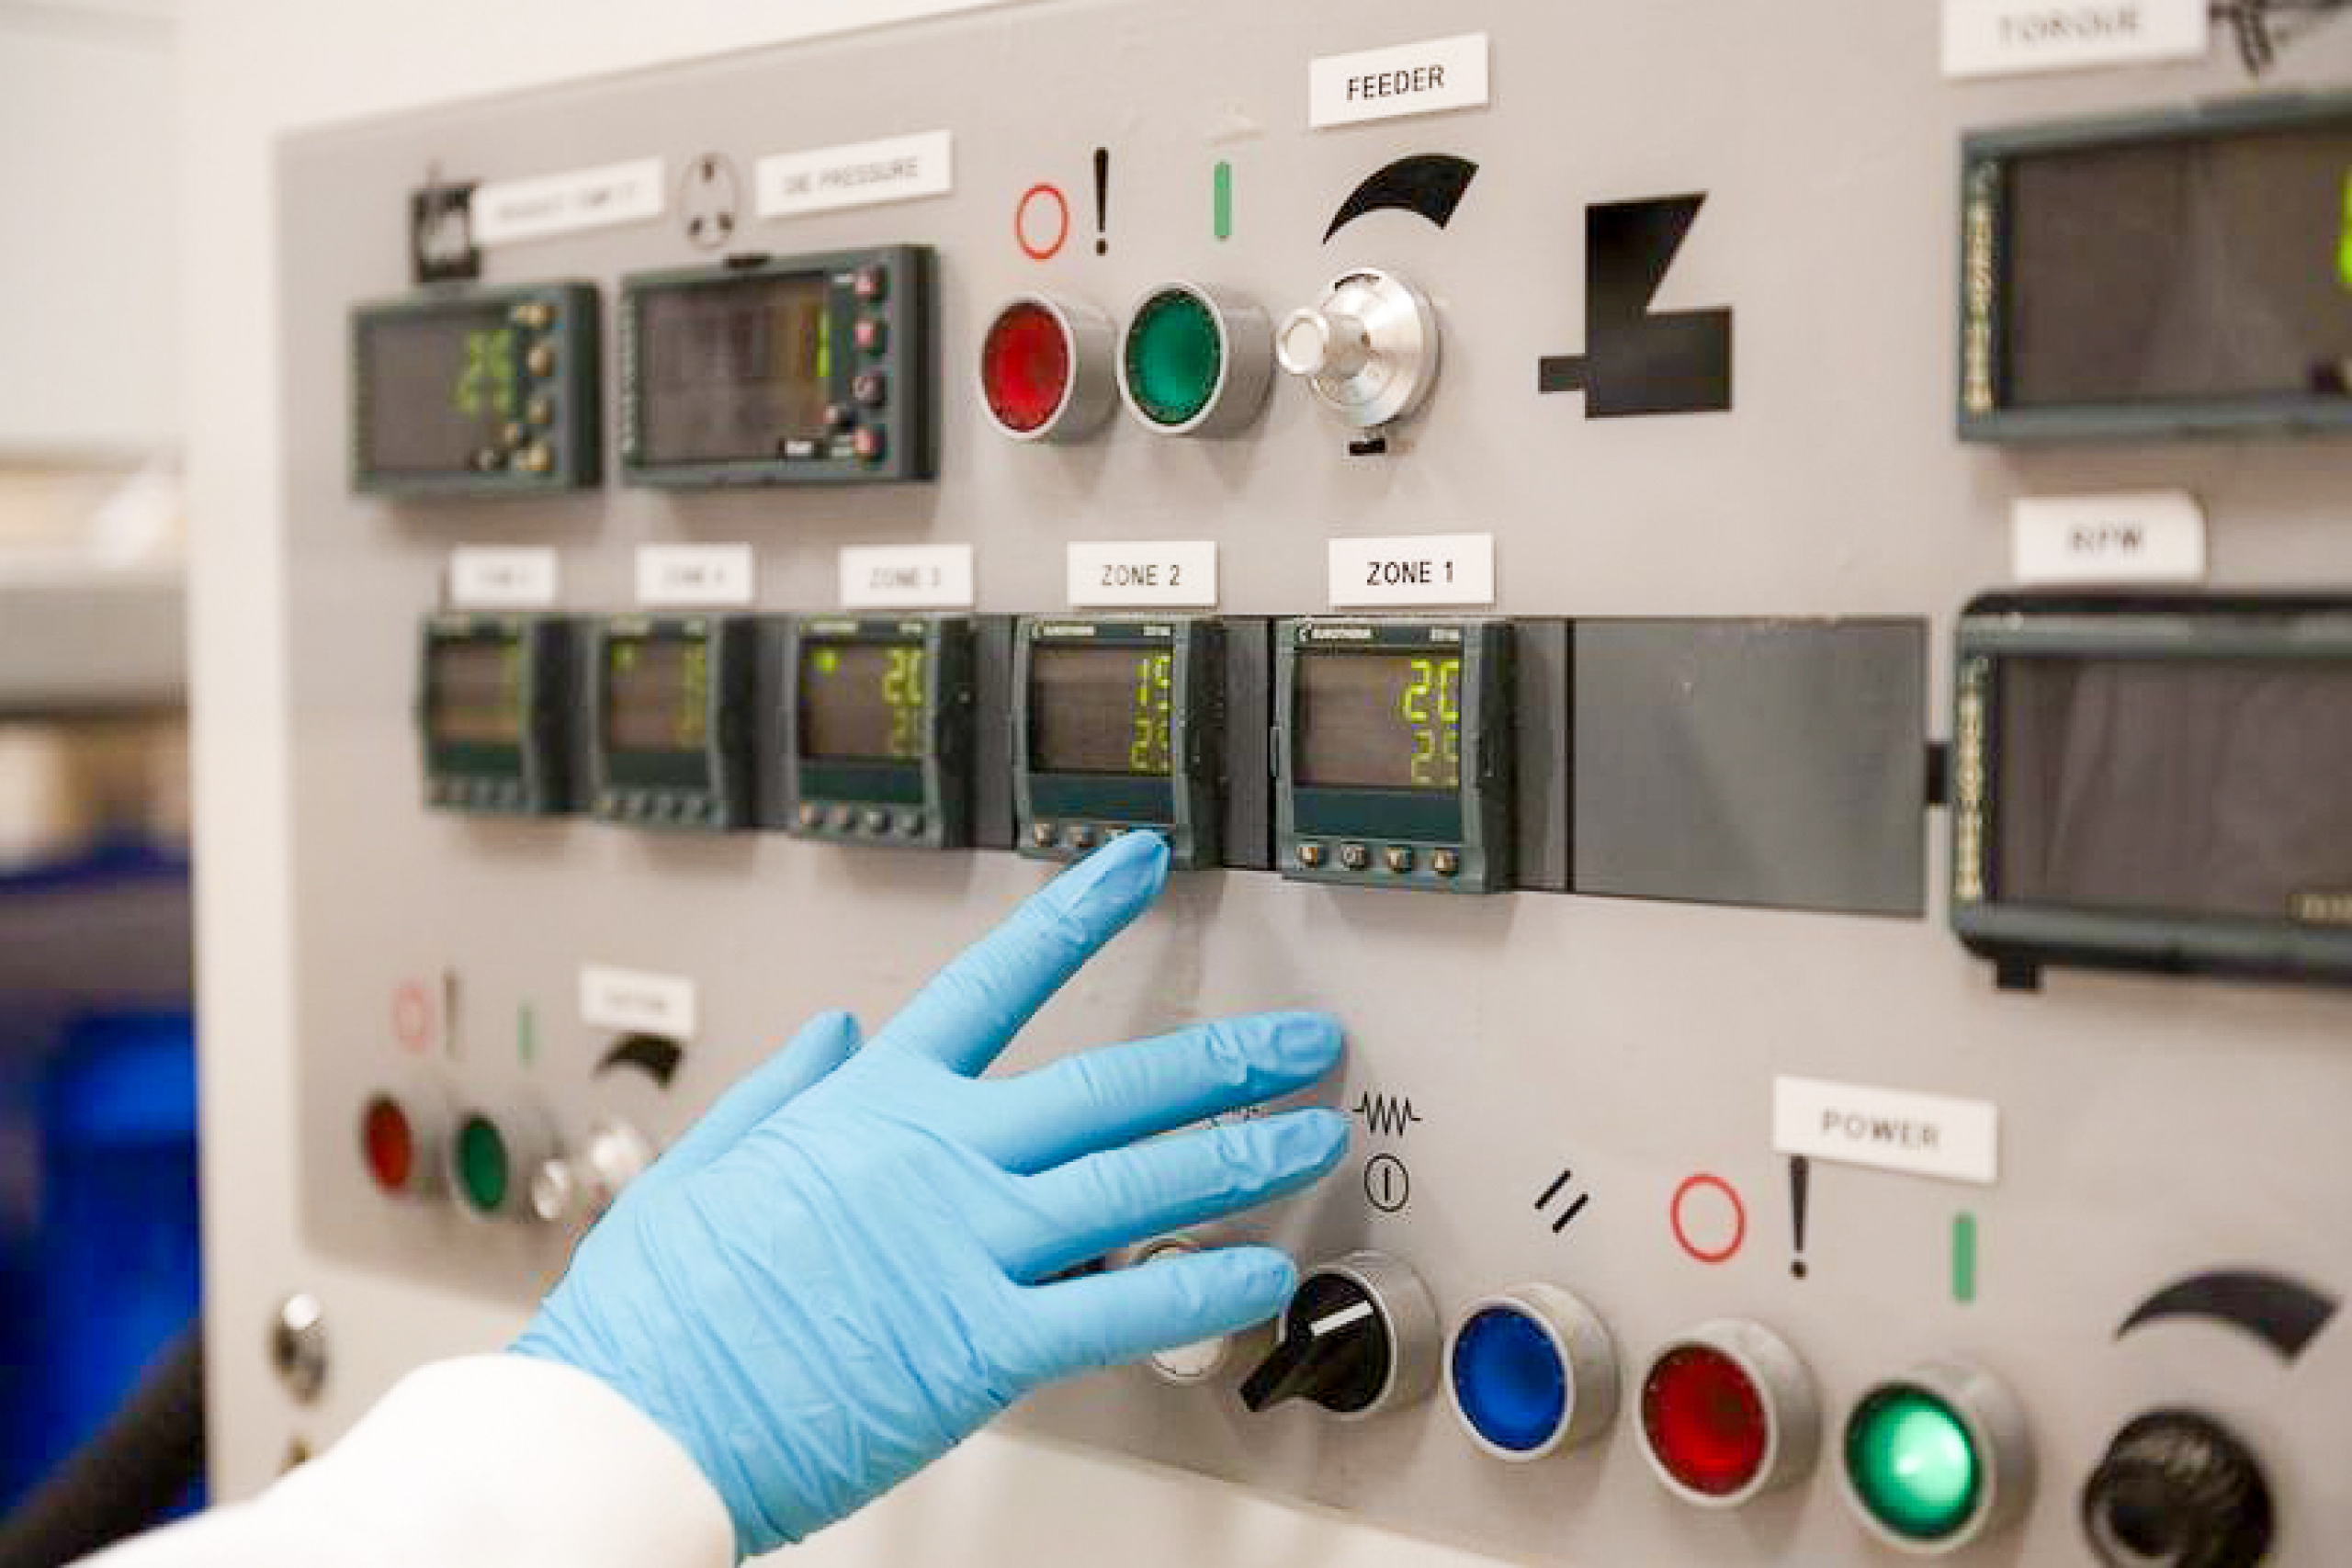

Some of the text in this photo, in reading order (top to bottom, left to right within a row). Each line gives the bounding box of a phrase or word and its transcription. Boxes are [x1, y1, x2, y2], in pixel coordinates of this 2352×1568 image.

[1347, 64, 1444, 101] FEEDER
[1101, 564, 1181, 586] ZONE 2
[1366, 559, 1453, 586] ZONE 1
[1822, 1108, 1939, 1150] POWER
